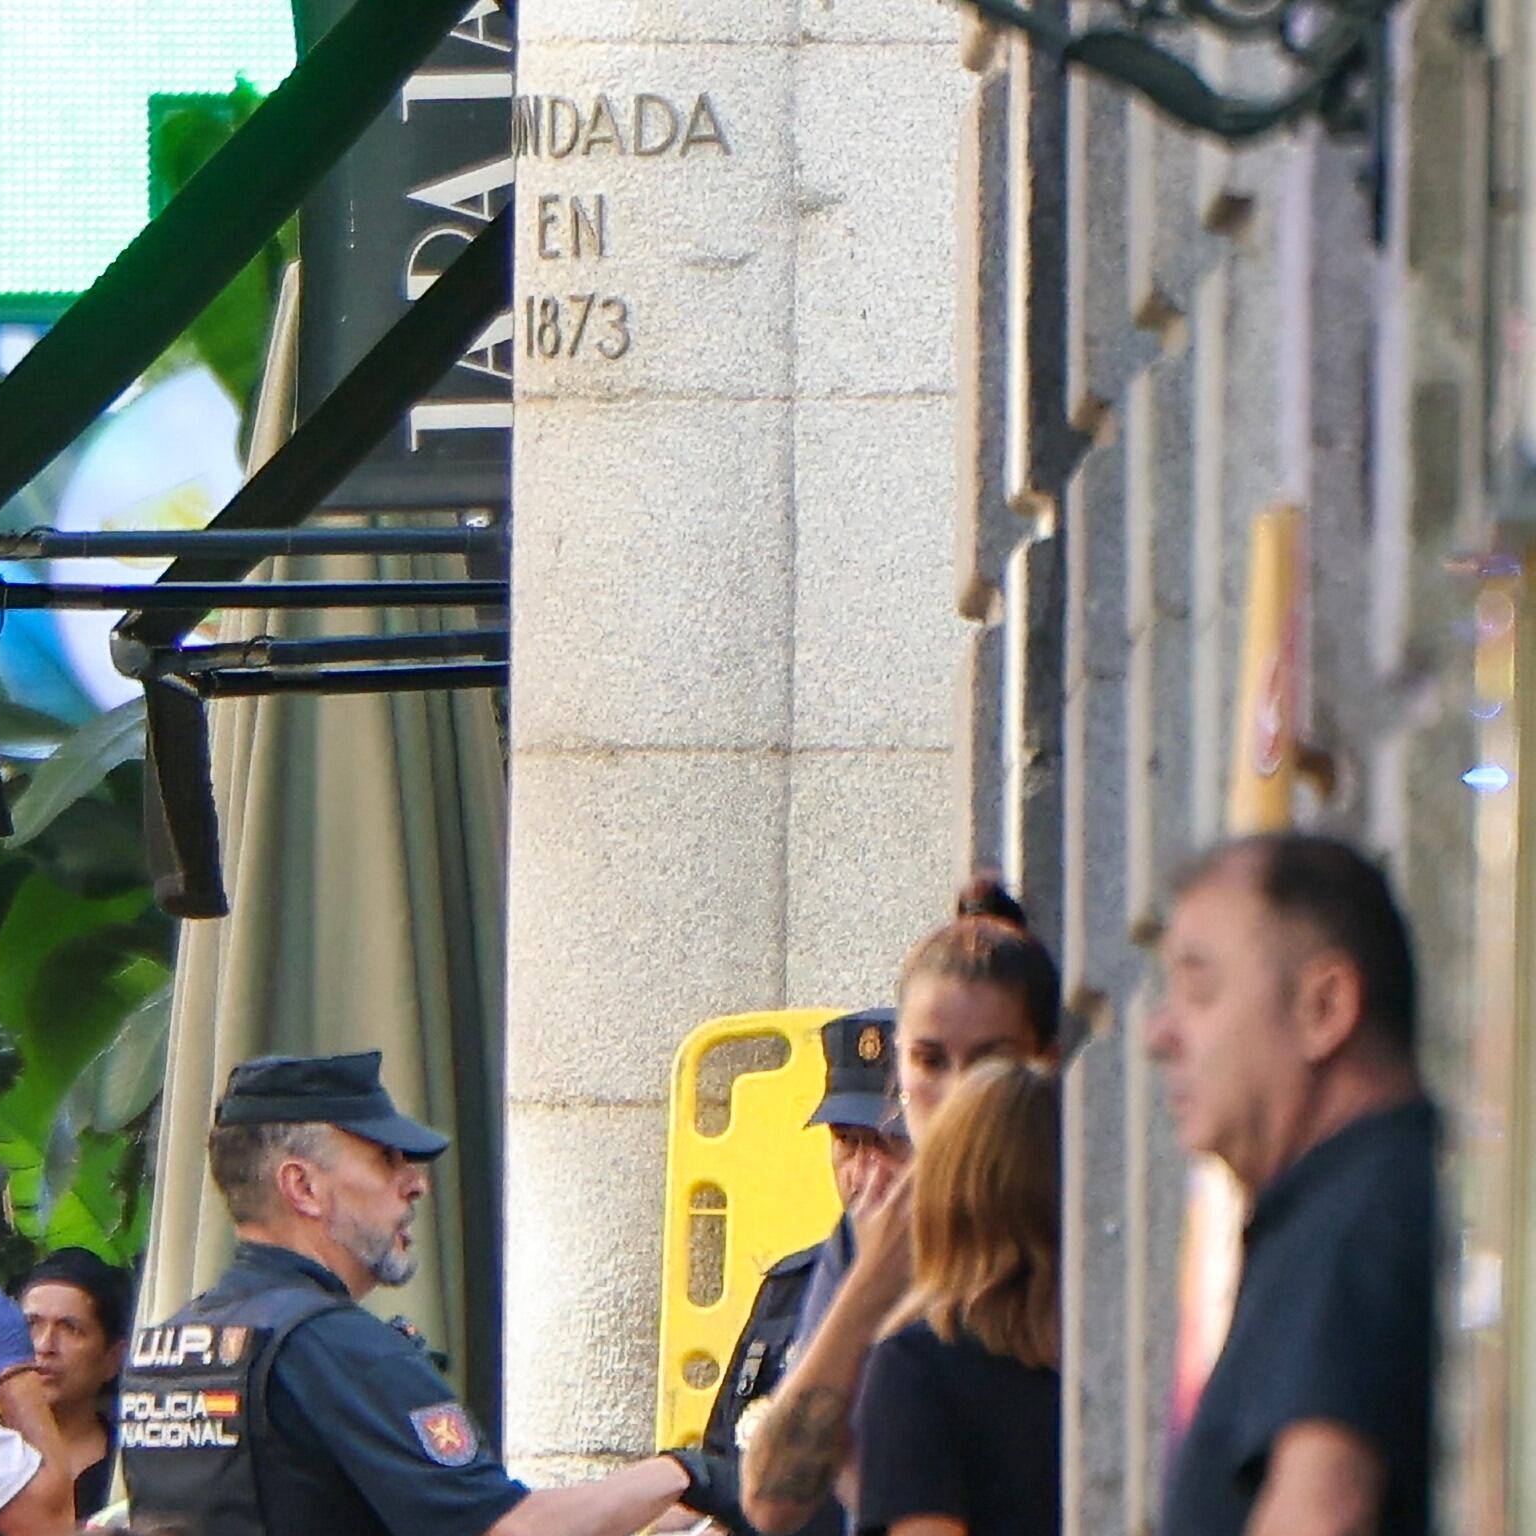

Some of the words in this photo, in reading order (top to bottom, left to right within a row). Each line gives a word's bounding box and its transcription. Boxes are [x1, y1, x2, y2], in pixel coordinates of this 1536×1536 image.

[537, 193, 607, 259] EN
[525, 293, 631, 360] 1873
[121, 1390, 208, 1420] POLICIA
[119, 1419, 240, 1448] NACIONAL
